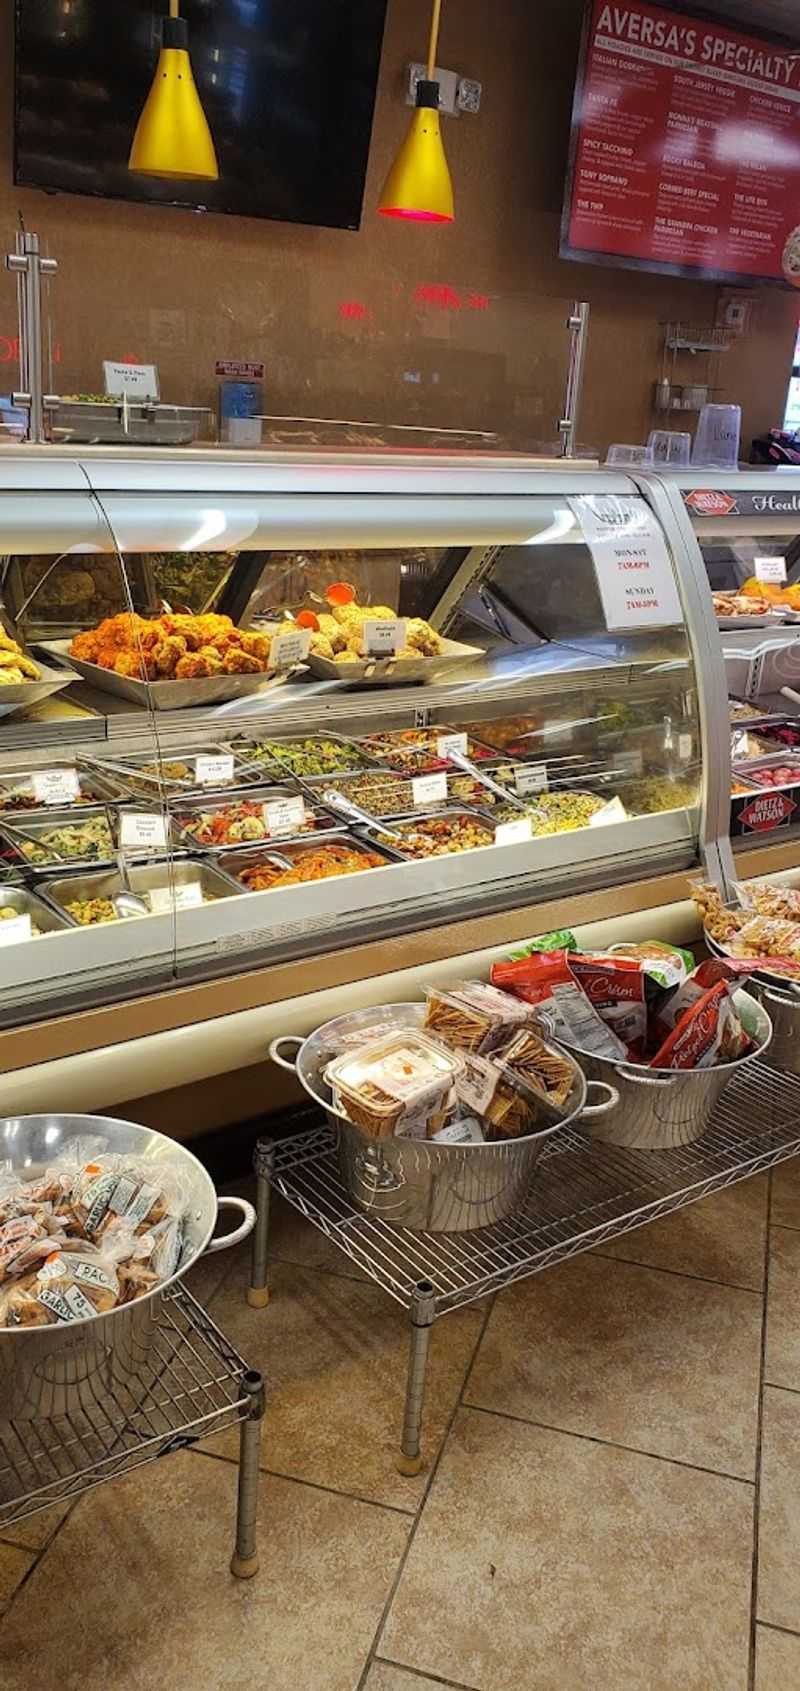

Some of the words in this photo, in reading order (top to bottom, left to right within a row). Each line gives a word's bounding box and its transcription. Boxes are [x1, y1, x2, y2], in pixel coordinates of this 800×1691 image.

[597, 5, 698, 55] AVERSA'S
[700, 35, 796, 84] SPECIALTY
[754, 799, 777, 813] DIETZ
[748, 807, 785, 824] WATSON
[40, 1291, 77, 1320] GARLIC
[71, 1293, 85, 1309] 75
